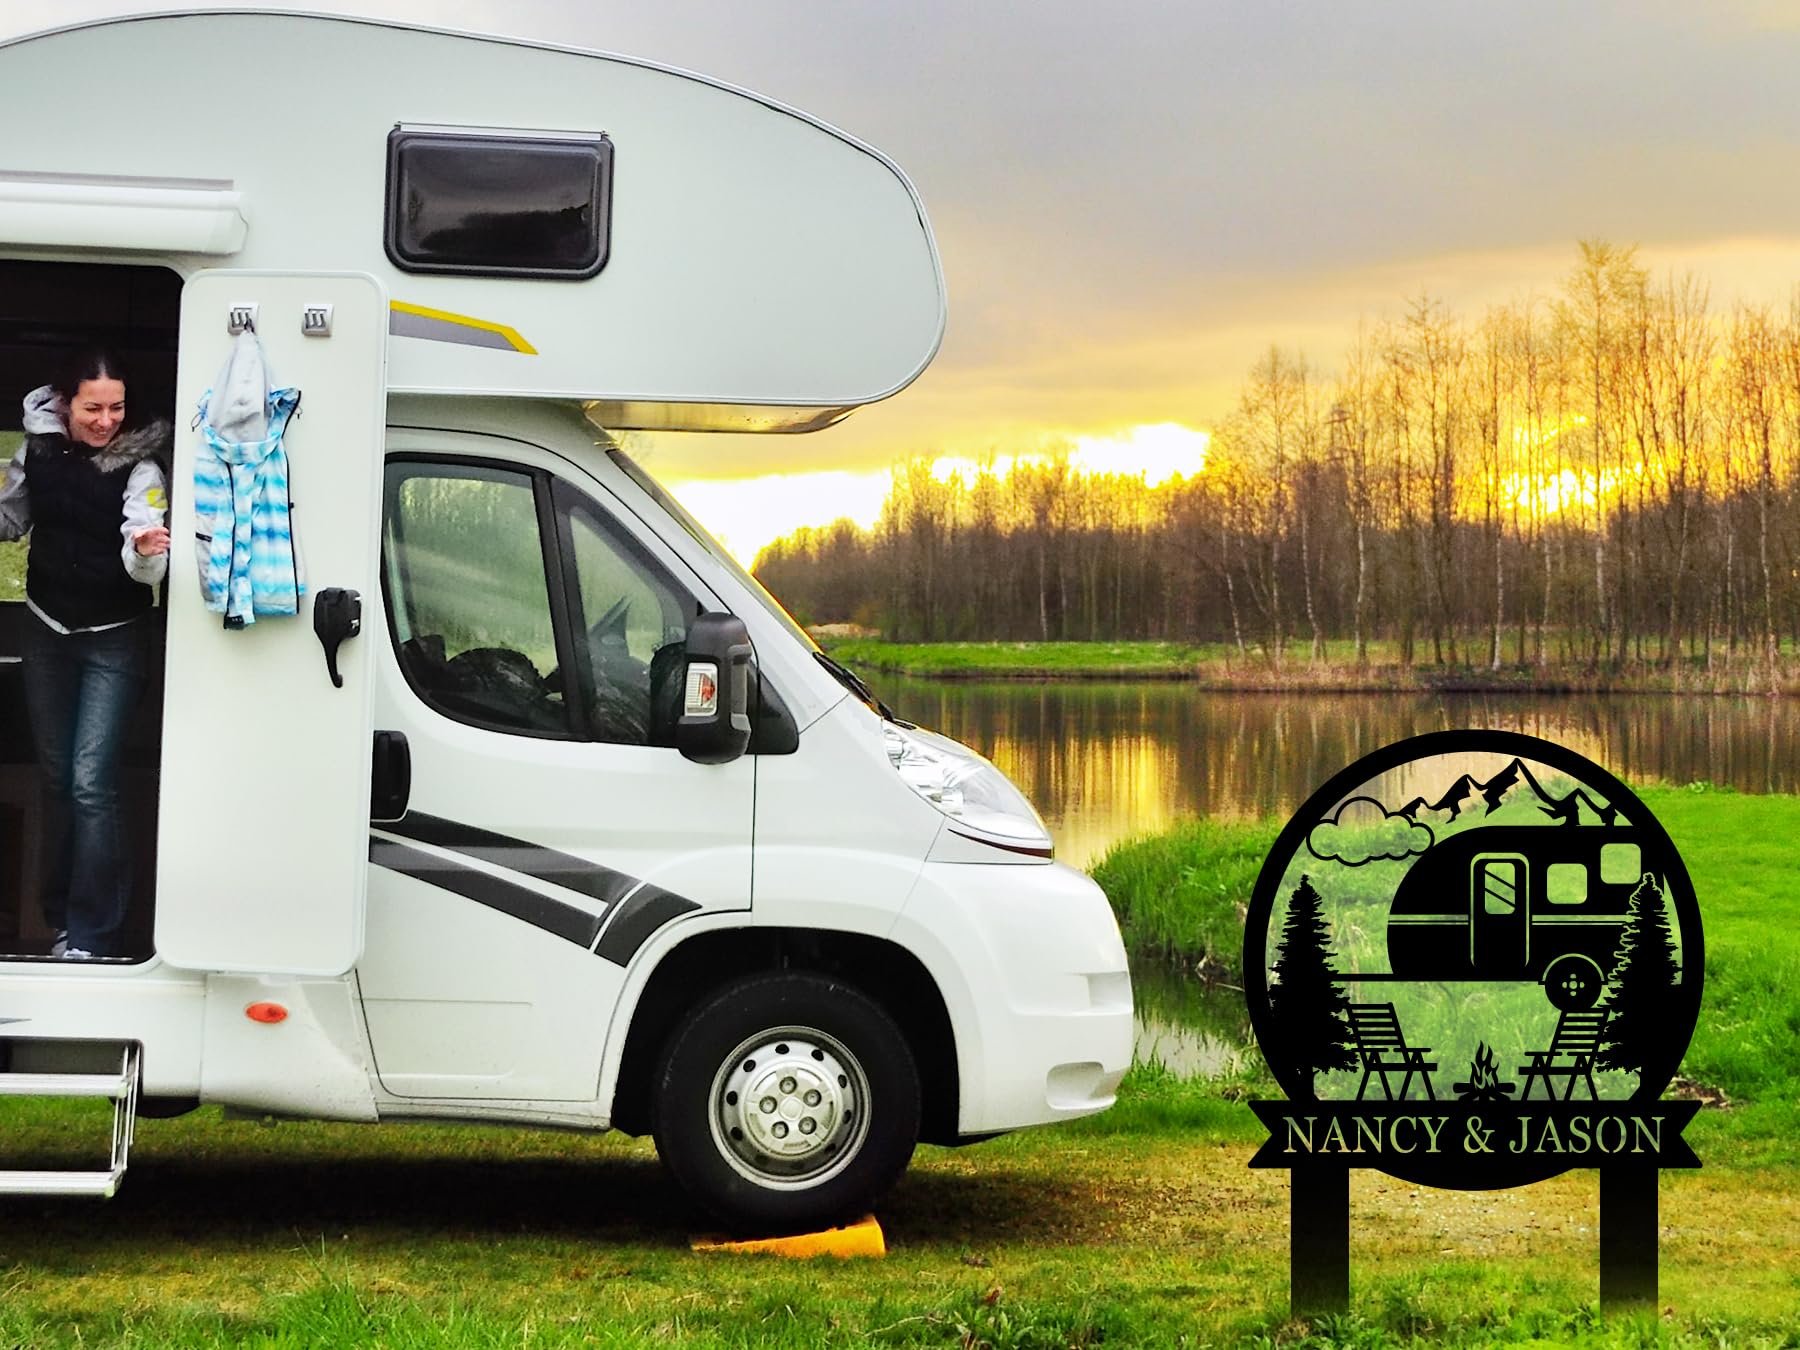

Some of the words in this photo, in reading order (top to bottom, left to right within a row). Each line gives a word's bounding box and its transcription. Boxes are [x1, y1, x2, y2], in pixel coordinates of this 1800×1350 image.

[1283, 1116, 1449, 1153] NANCY
[1463, 1116, 1495, 1153] &
[1509, 1116, 1665, 1153] JASON
